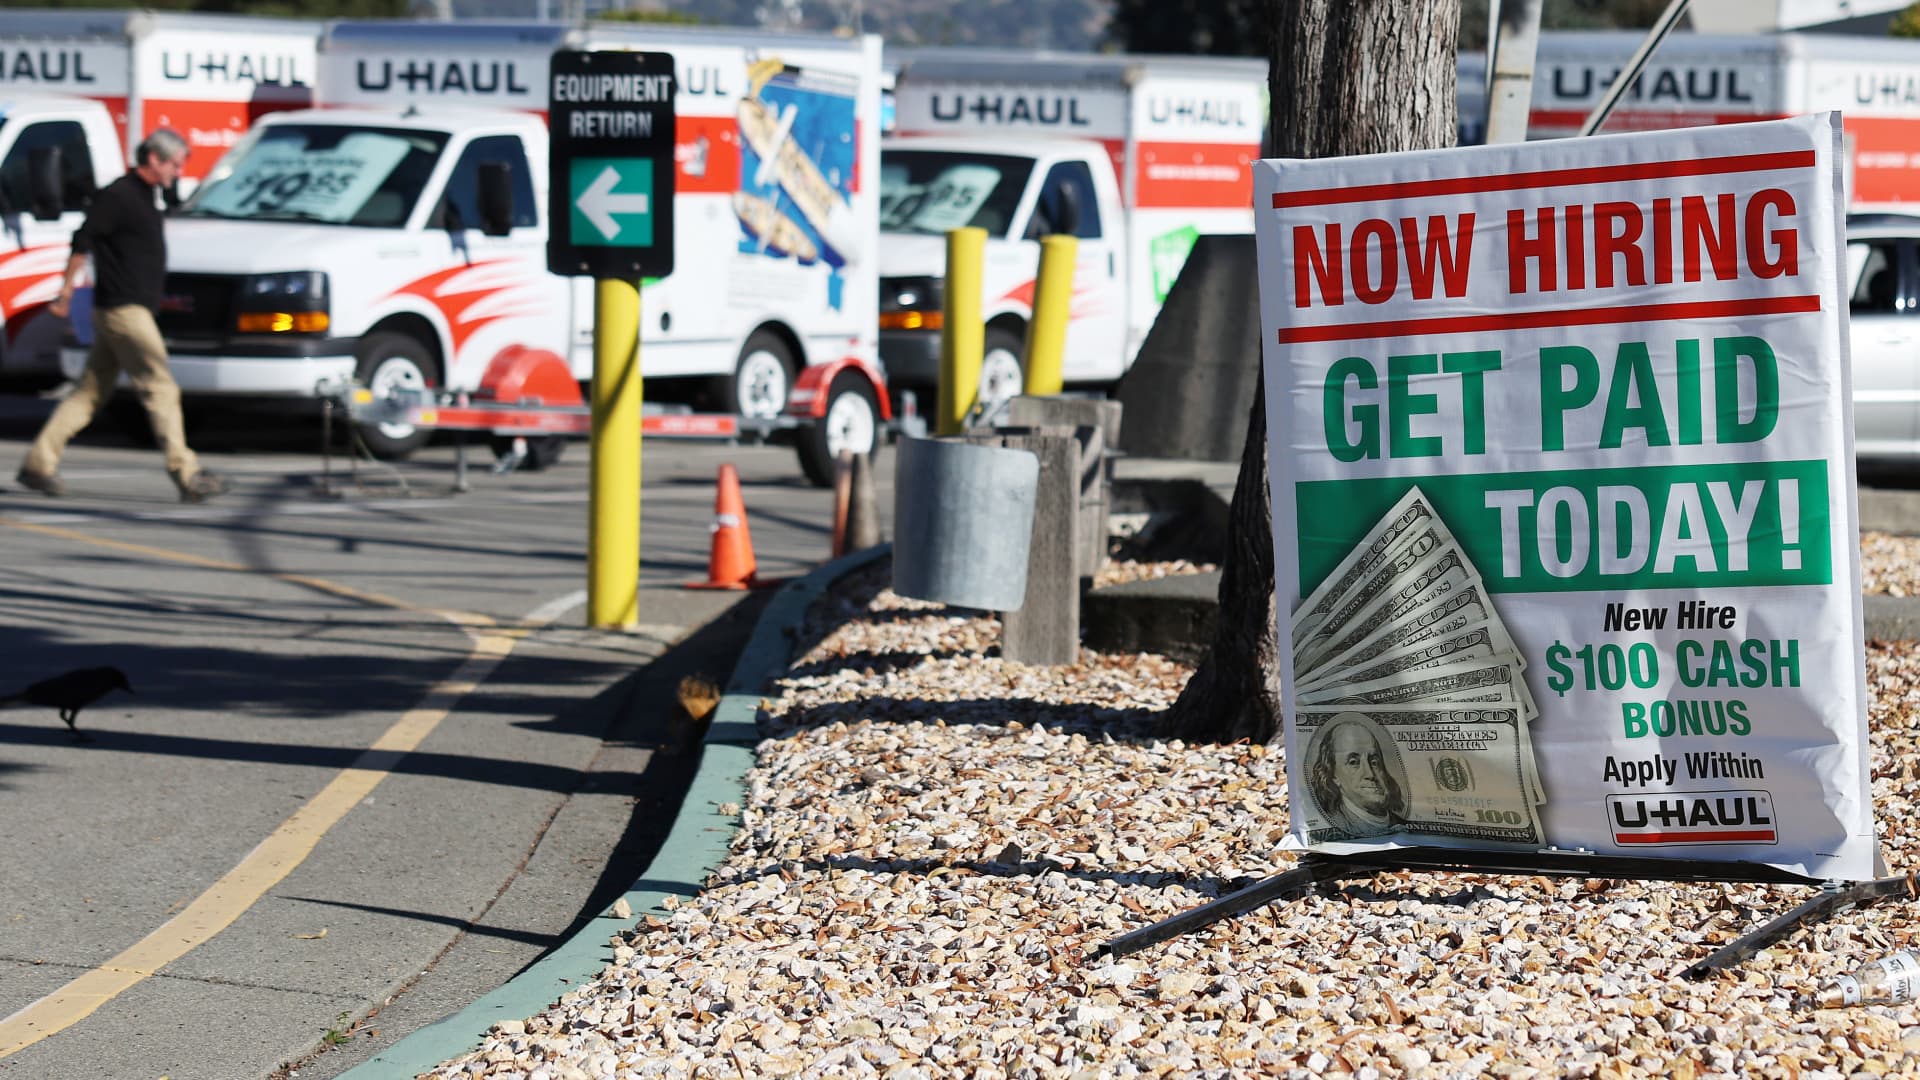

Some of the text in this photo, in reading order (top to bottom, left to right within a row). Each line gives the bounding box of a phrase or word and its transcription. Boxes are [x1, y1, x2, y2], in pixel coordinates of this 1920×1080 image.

[162, 51, 306, 86] U-HAUL
[356, 60, 529, 94] U-HAUL
[554, 75, 673, 101] EQUIPMENT
[1856, 75, 1920, 103] U-HA
[570, 111, 652, 137] RETURN
[931, 95, 1090, 126] U-HAUL
[1149, 97, 1247, 127] U-HAUL
[1293, 212, 1476, 308] NOW
[1506, 188, 1799, 294] HIRING
[1323, 335, 1780, 464] GET PAID
[1485, 479, 1802, 579] TODAY!
[1394, 535, 1434, 573] 50
[1392, 557, 1452, 612] 100
[1405, 593, 1471, 637] 100
[1603, 600, 1736, 632] New Hire
[1412, 632, 1482, 665] 100
[1478, 665, 1511, 687] 20
[1545, 639, 1800, 697] $100 CASH
[1436, 710, 1509, 723] 100
[1622, 700, 1751, 738] BONUS
[1392, 730, 1497, 741] UNITED STATES
[1603, 752, 1764, 788] Apply Within
[1475, 809, 1521, 825] 100
[1613, 797, 1770, 828] U-HAUL
[1480, 829, 1530, 839] DOLLARS
